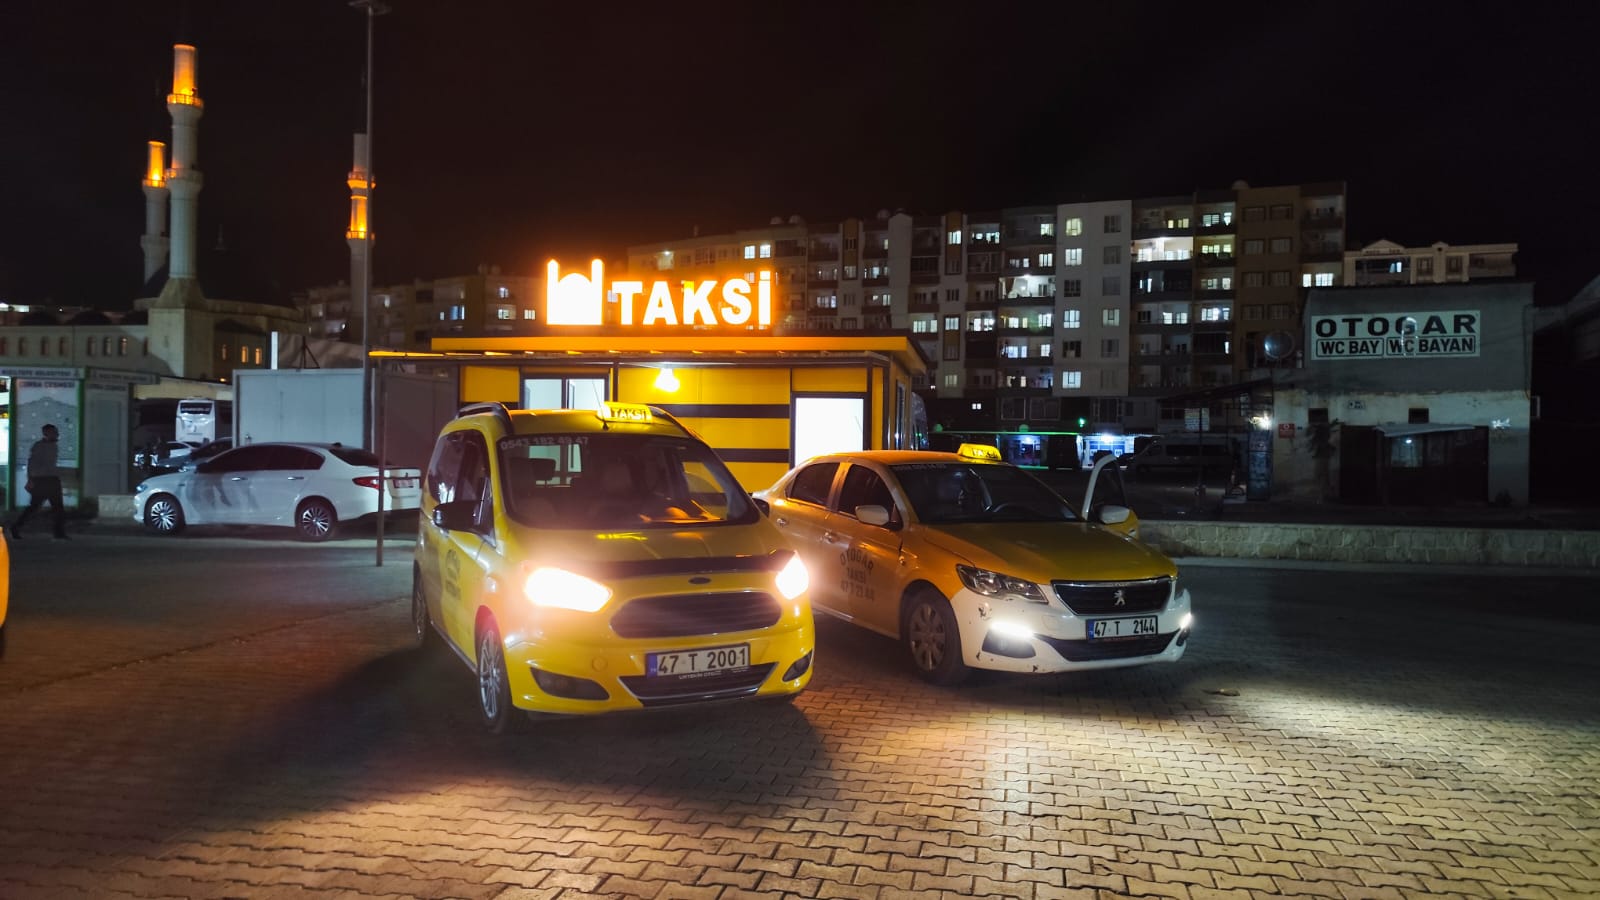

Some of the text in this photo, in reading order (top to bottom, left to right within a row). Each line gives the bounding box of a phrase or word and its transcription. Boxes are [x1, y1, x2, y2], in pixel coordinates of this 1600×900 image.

[611, 270, 771, 325] TAKSİ
[1315, 314, 1476, 338] OTOGAR
[1321, 340, 1380, 355] WC BAY
[1389, 337, 1474, 353] WC BAYAN
[1095, 619, 1155, 636] 47 T 2144
[658, 655, 679, 673] 47
[688, 653, 698, 671] T
[707, 648, 746, 669] 2001
